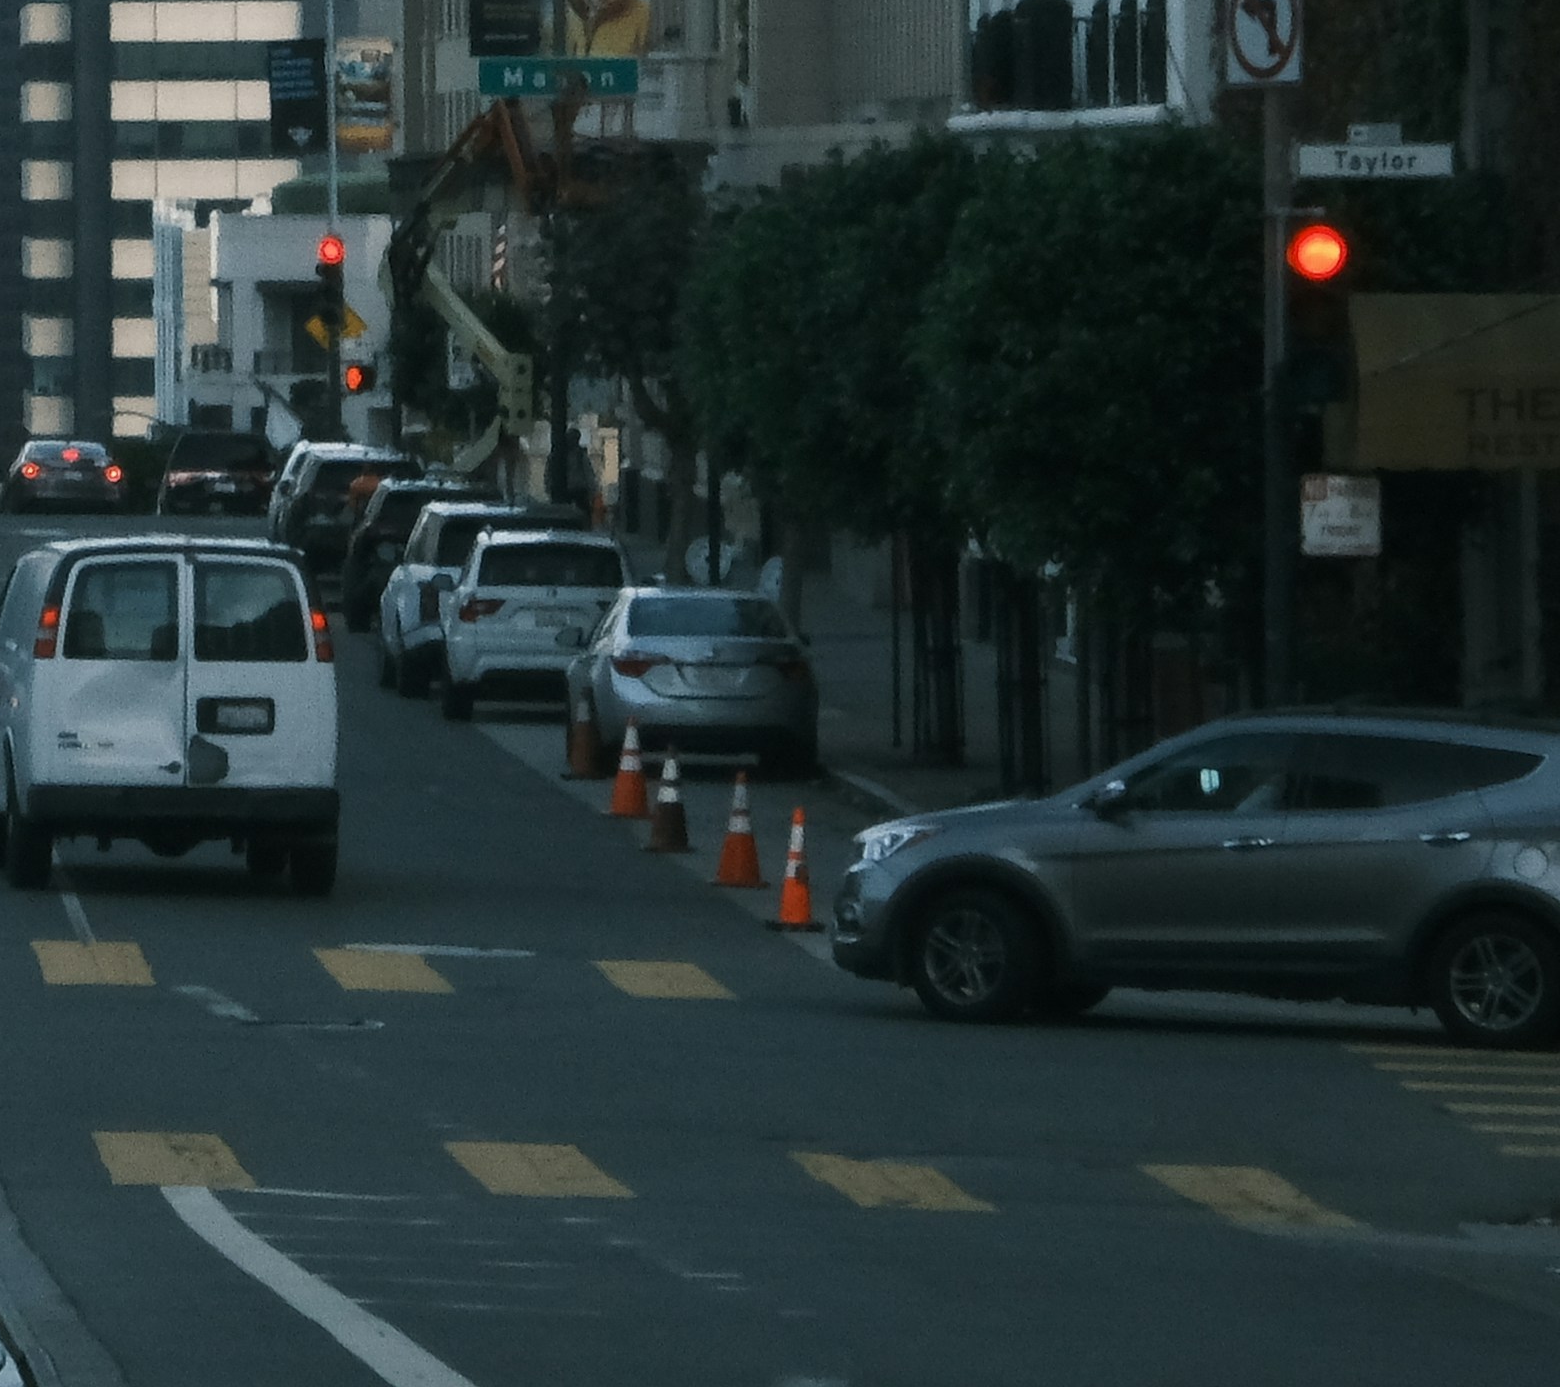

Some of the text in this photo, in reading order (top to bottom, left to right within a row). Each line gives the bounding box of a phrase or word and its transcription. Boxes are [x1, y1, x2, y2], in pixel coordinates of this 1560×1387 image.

[503, 66, 615, 89] Man
[1334, 149, 1417, 176] Taylor
[1457, 386, 1560, 421] THE
